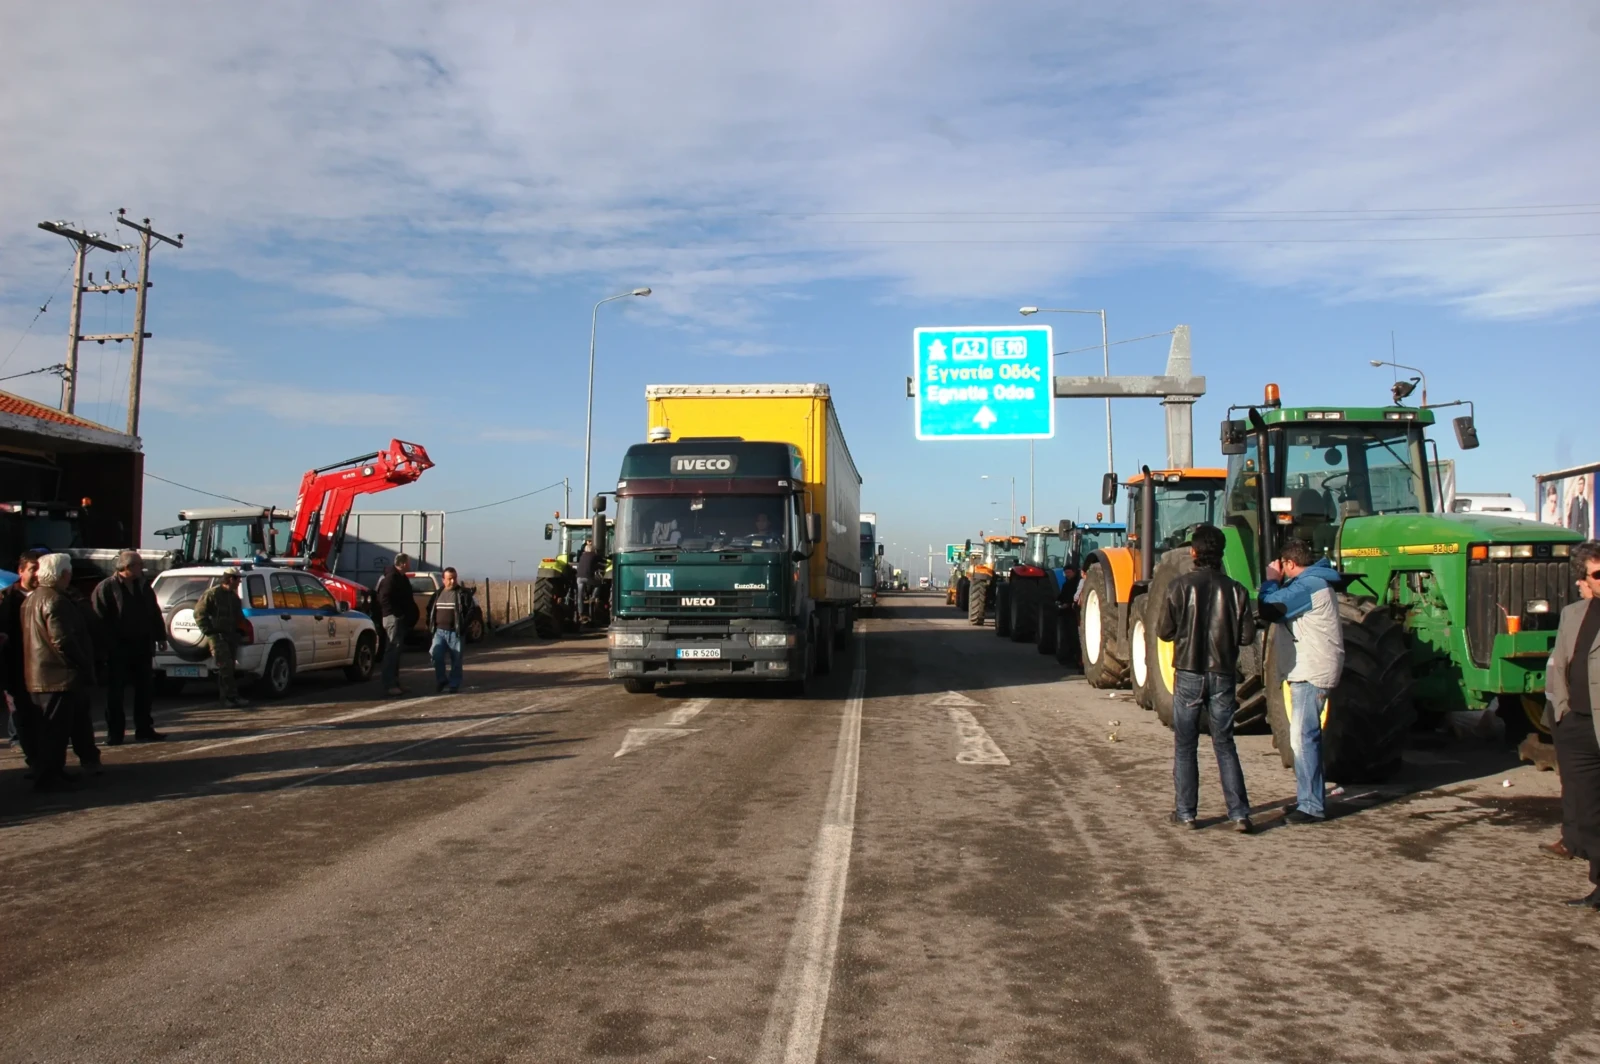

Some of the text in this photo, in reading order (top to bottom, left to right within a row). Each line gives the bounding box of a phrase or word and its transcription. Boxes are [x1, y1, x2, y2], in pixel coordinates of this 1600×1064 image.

[960, 340, 980, 356] A2
[927, 363, 1041, 384] Εγνατία Οδός
[927, 384, 1036, 405] Egnatia Odos
[677, 459, 731, 471] IVECO
[646, 572, 672, 588] TIR
[681, 597, 716, 606] IVECO
[681, 649, 720, 658] 16 R 5206
